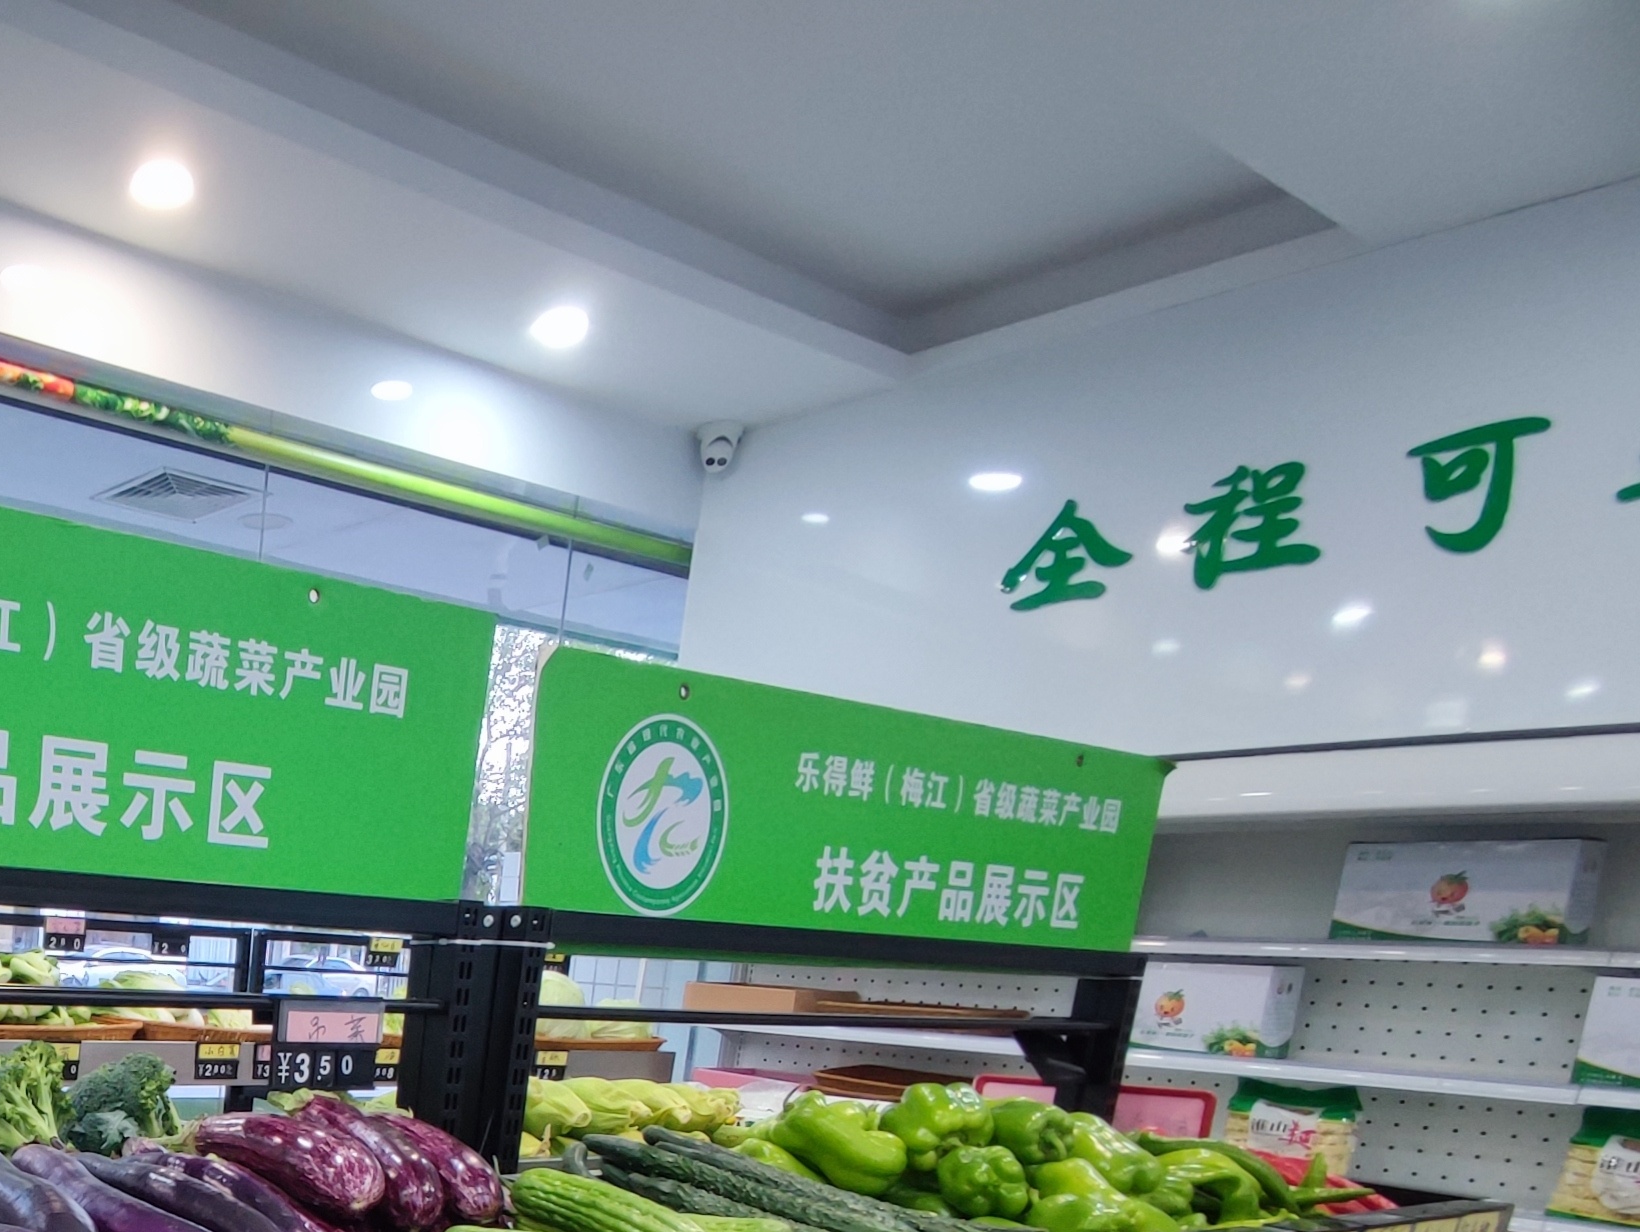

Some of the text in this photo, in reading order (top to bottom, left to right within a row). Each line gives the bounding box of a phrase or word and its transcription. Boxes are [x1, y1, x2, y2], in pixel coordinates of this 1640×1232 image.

[1000, 417, 1640, 611] 全程可
[795, 752, 1122, 834] 乐得鲜（梅江）省级蔬菜产业园
[813, 845, 1085, 930] 扶贫产品展示区
